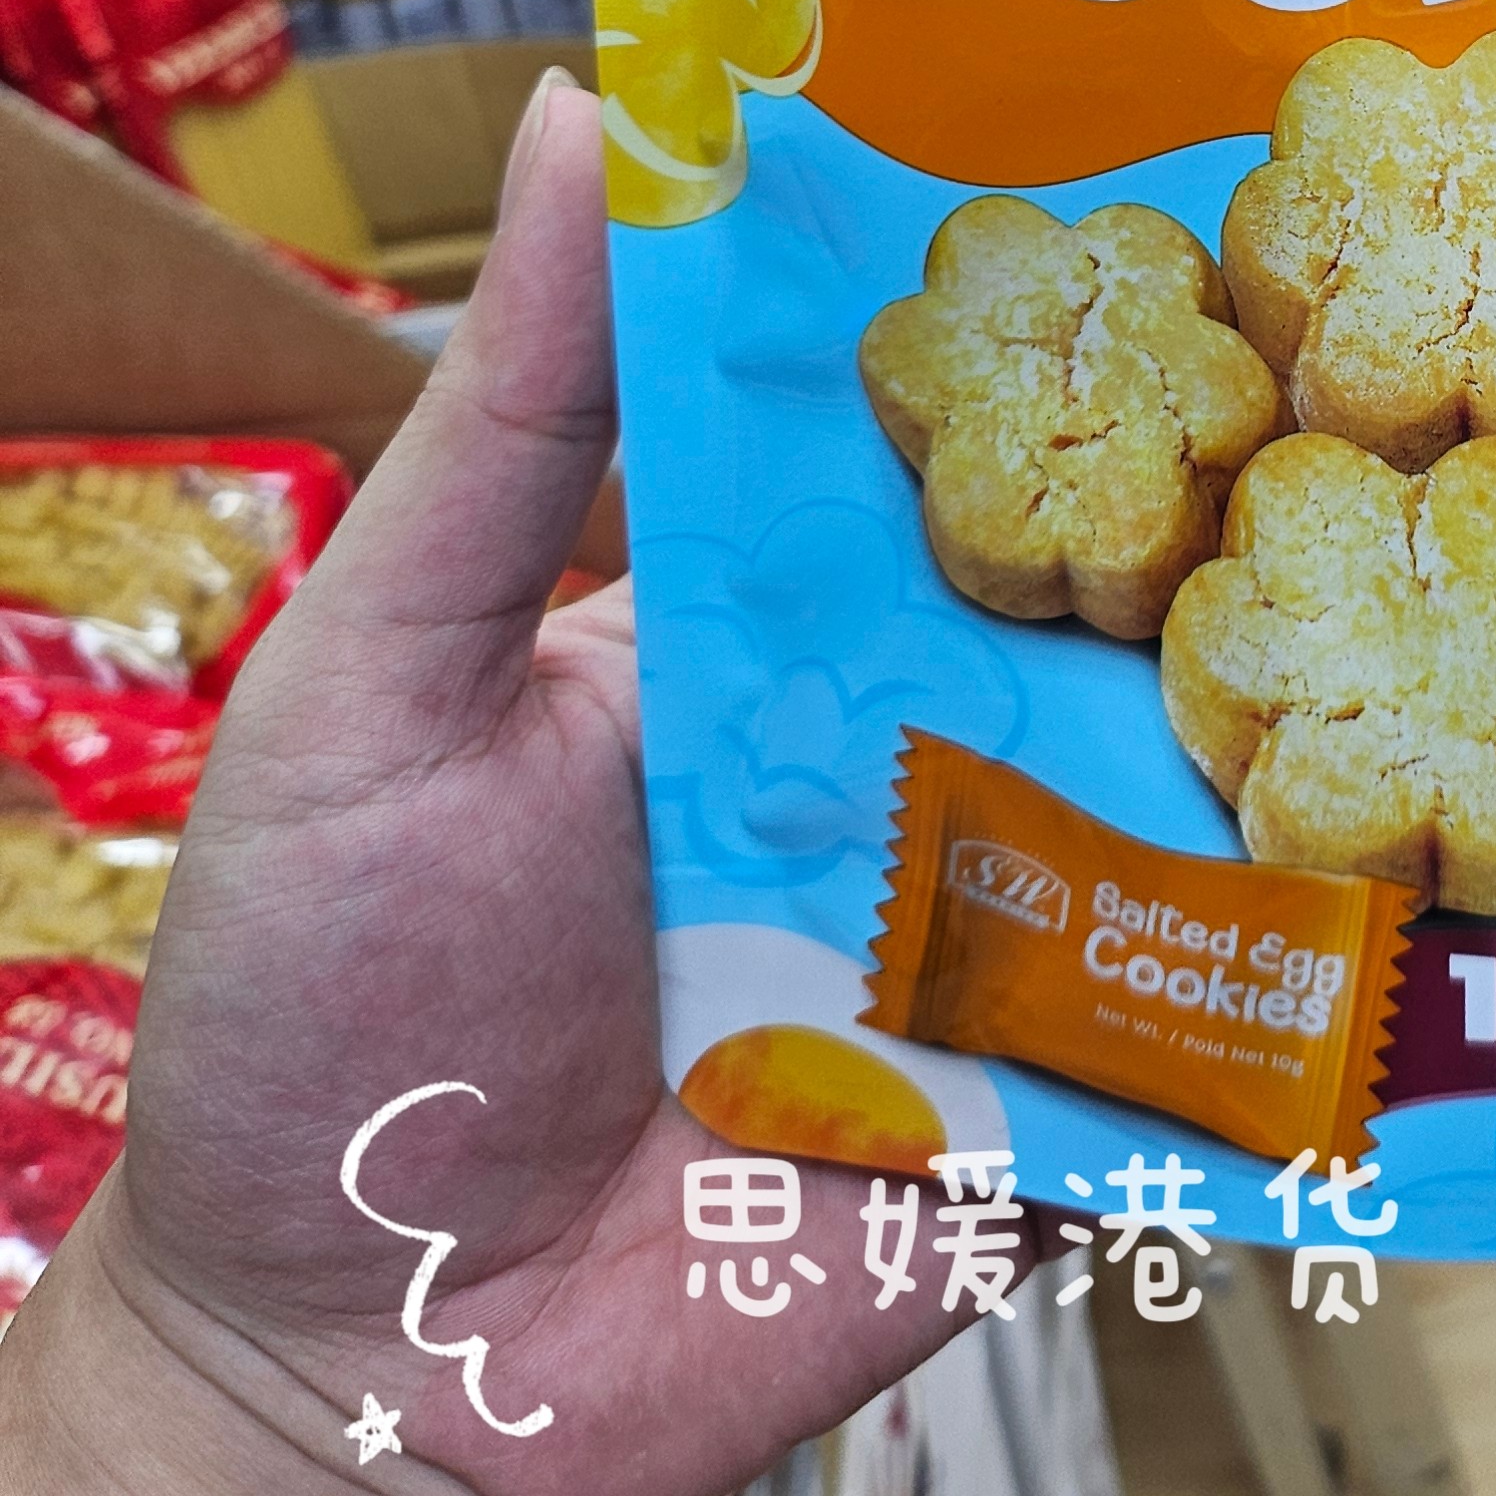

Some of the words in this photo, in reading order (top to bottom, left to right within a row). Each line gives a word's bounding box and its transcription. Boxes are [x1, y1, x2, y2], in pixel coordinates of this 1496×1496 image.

[1085, 925, 1333, 1037] Cookies
[1092, 880, 1240, 962] Salted
[1248, 930, 1346, 998] Egg
[1094, 1002, 1127, 1029] Net
[1182, 1033, 1225, 1058] Poid
[1230, 1045, 1265, 1066] Net
[1271, 1054, 1305, 1079] 10g
